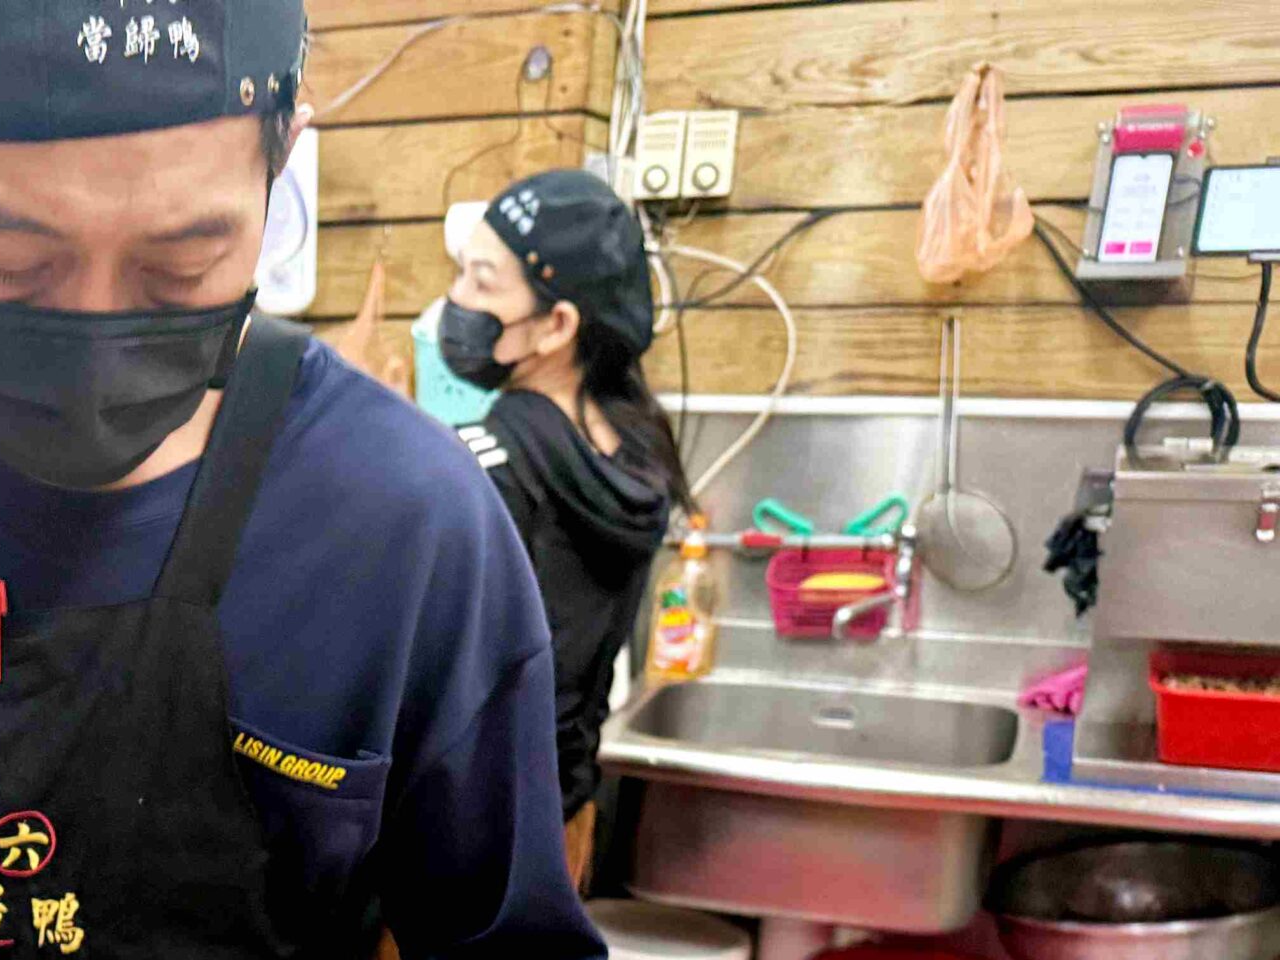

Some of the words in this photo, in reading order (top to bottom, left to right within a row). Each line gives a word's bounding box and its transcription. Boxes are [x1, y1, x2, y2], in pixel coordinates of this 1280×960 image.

[77, 15, 200, 65] 當歸鴨
[233, 732, 283, 767] LISIN
[280, 754, 347, 786] GROUP
